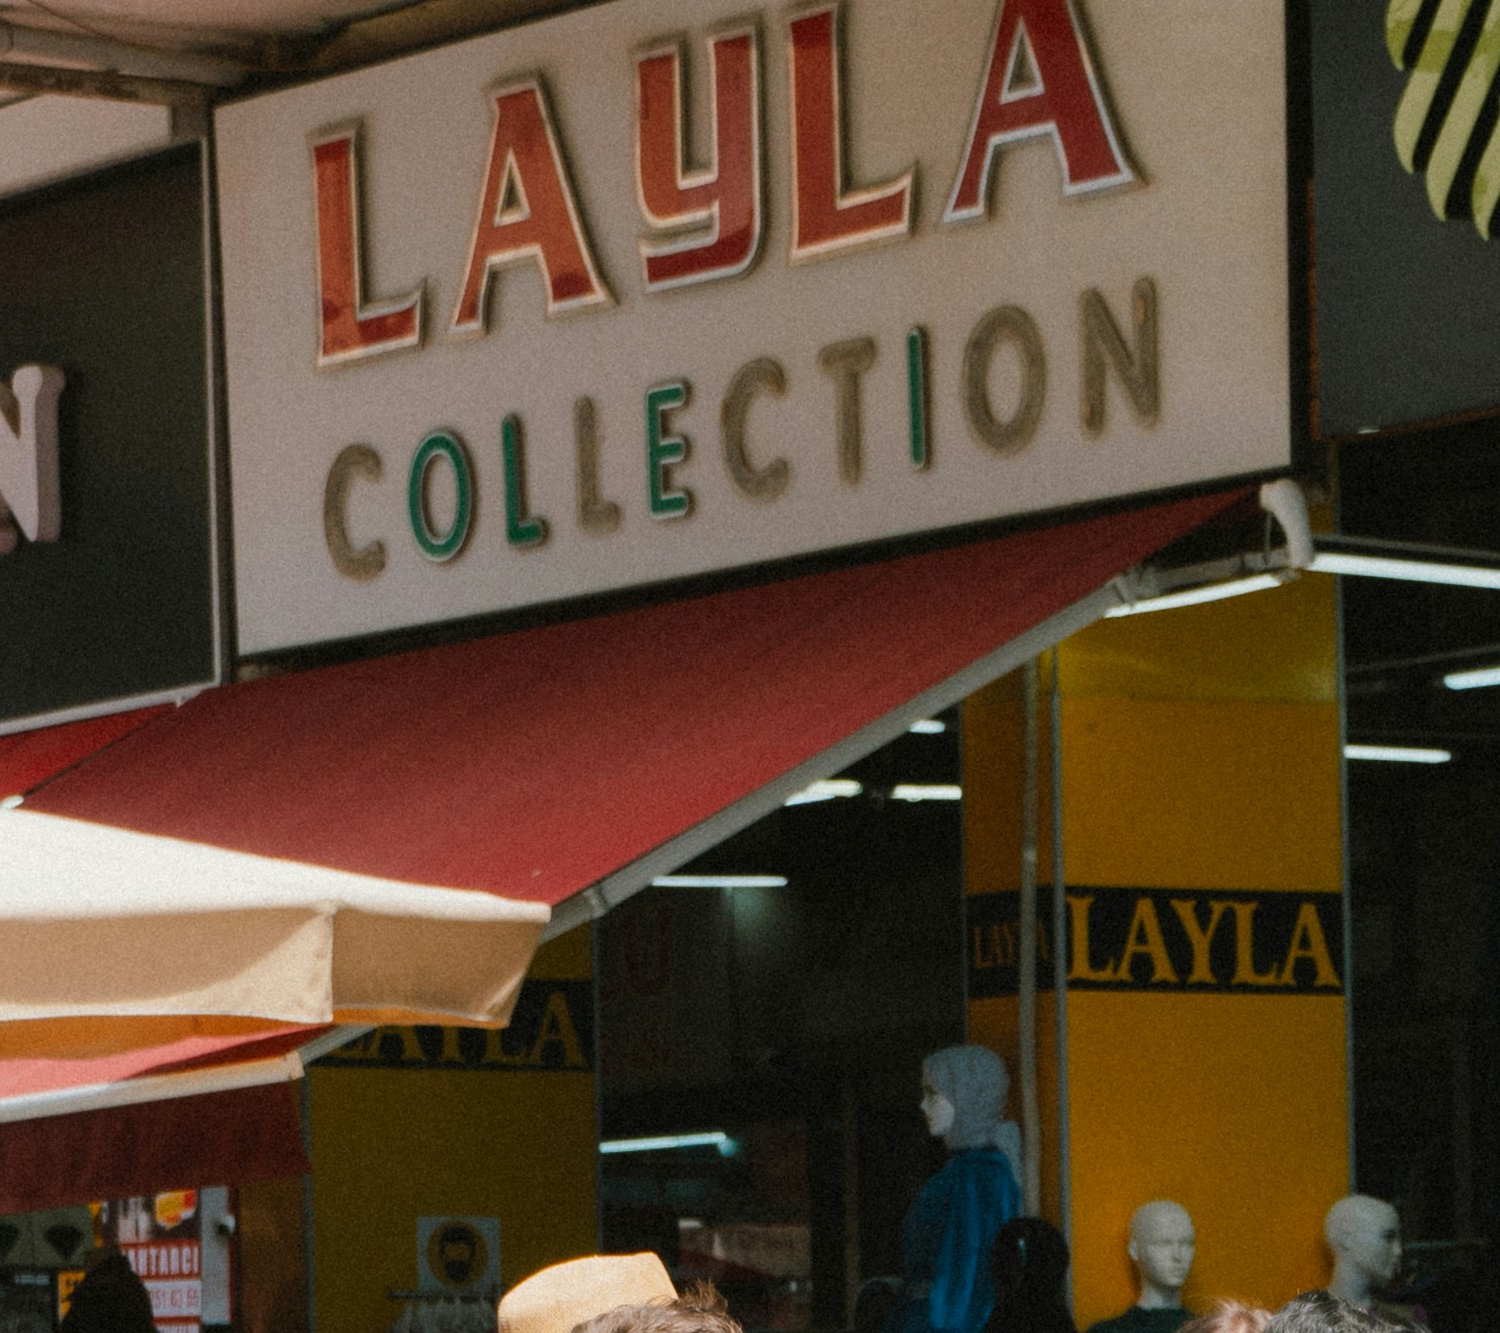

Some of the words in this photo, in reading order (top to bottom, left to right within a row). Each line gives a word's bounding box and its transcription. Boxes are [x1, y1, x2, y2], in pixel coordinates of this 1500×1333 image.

[311, 0, 1150, 372] LAYLA
[322, 275, 1162, 584] COLLECTION
[1067, 895, 1342, 988] LAYLA
